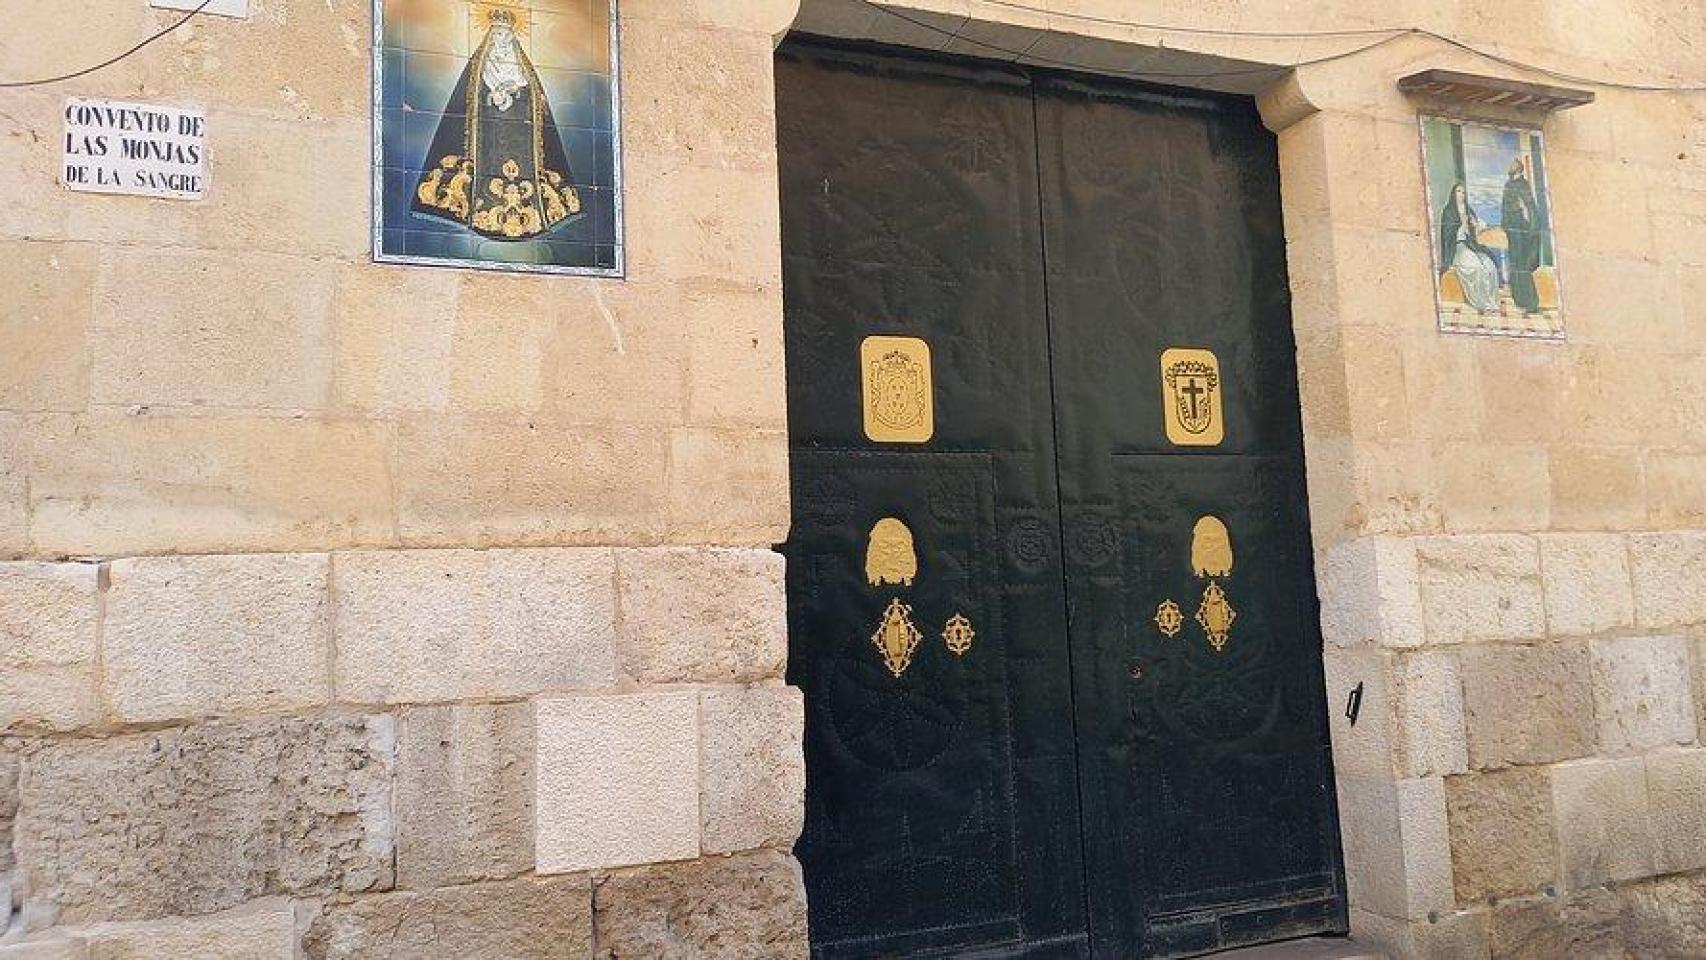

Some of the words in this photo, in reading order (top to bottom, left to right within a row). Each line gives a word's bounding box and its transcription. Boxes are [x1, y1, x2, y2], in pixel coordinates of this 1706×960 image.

[65, 105, 170, 133] CONVENTO
[178, 115, 204, 137] DE
[66, 133, 108, 156] LAS
[121, 138, 200, 165] MONJAS
[66, 165, 89, 183] DE
[97, 167, 122, 185] LA
[135, 169, 202, 192] SANGRE
